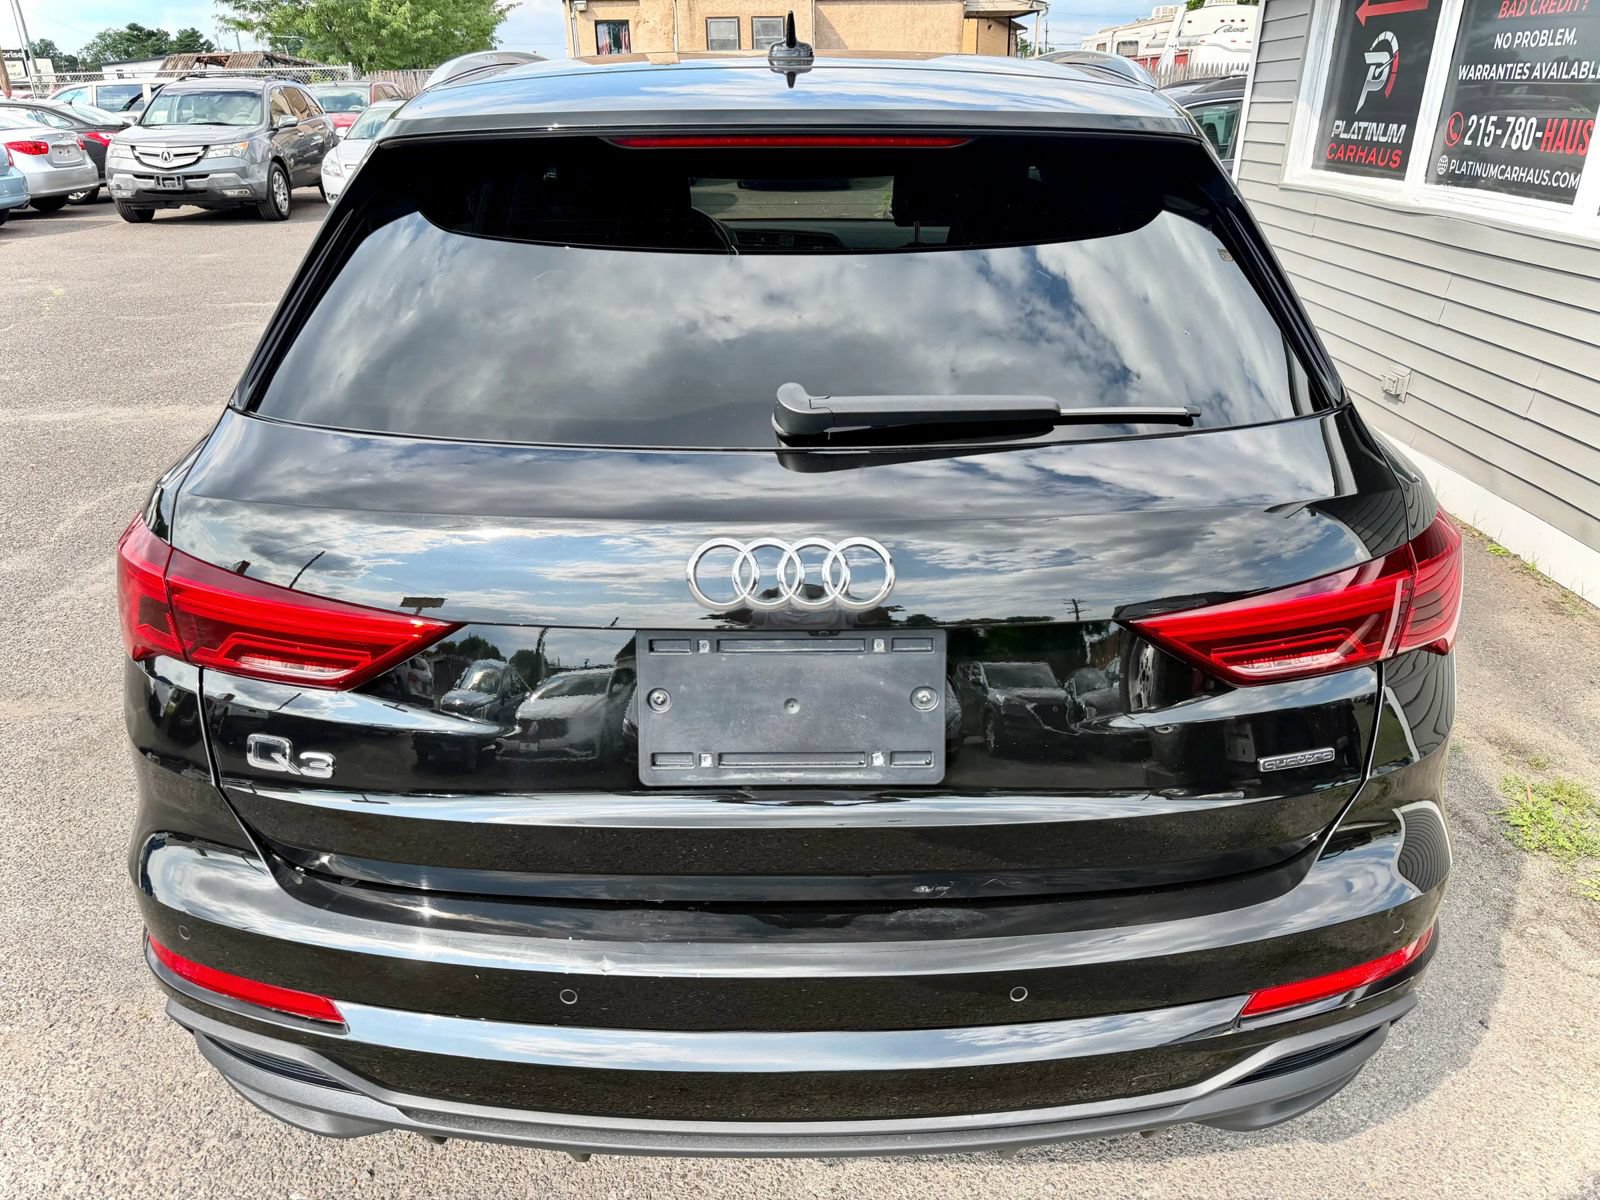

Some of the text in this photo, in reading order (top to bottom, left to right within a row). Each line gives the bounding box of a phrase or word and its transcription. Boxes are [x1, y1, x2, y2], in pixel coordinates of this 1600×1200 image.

[1498, 0, 1528, 19] BAD
[1493, 27, 1578, 50] NO PROBLEM.
[1458, 62, 1531, 80] WARRANTIES
[1331, 120, 1407, 144] PLATINUM
[1464, 114, 1595, 156] 215-780-HAUS
[1326, 143, 1403, 169] CARHAUS
[1449, 159, 1582, 190] PLATINUMCARHAUS.COM
[246, 733, 337, 779] Q3
[1264, 751, 1333, 769] quattro
